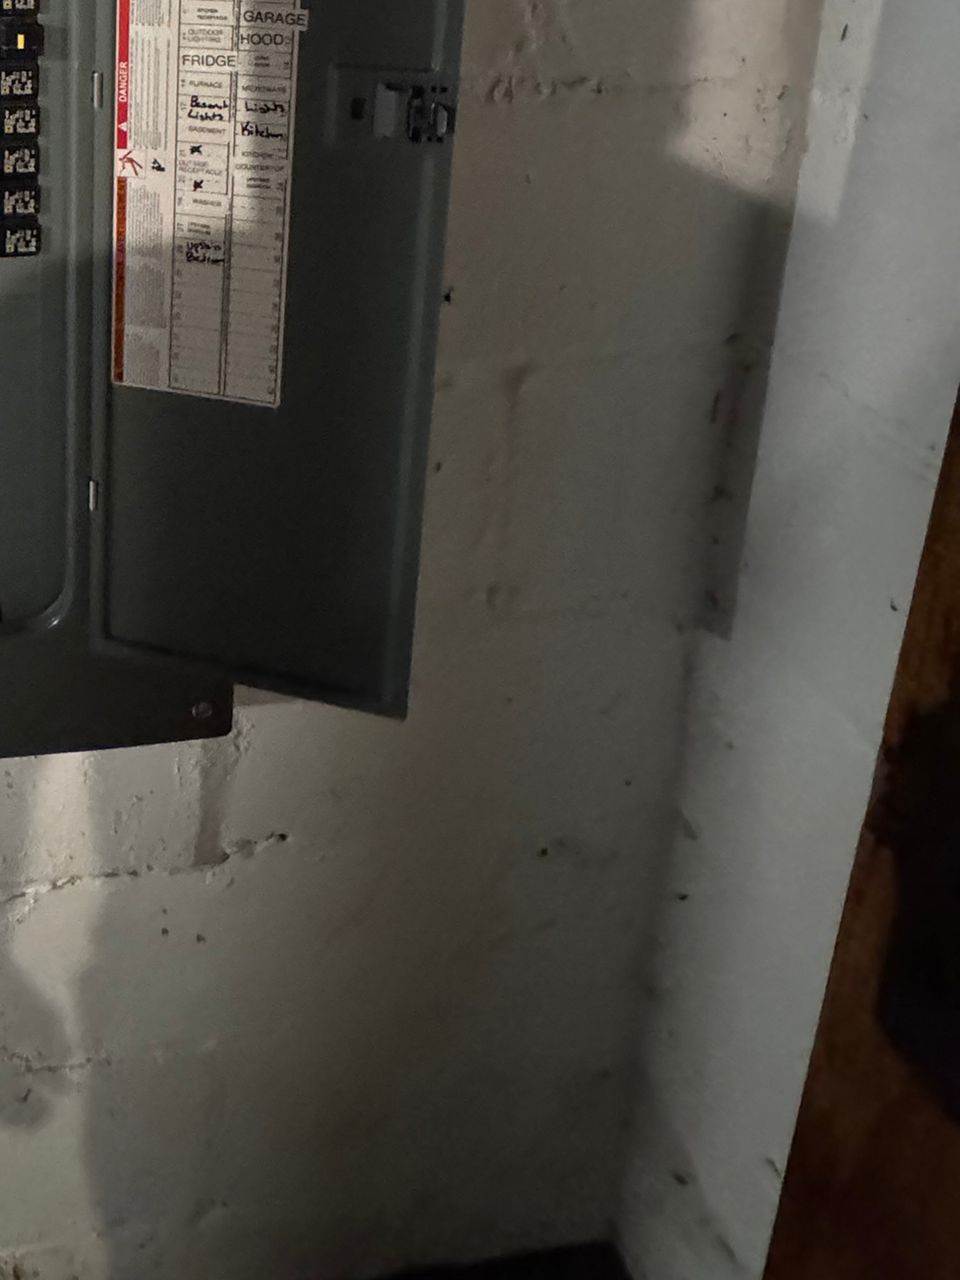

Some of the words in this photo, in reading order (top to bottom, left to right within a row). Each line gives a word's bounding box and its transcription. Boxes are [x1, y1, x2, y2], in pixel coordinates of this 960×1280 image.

[243, 10, 307, 26] GARAGE
[241, 33, 284, 45] HOOD
[182, 54, 236, 67] FRIDGE
[118, 61, 128, 102] DANGER
[189, 80, 223, 88] FURNACE
[188, 126, 226, 135] BASEMENT
[235, 164, 285, 172] COUNTERTOP
